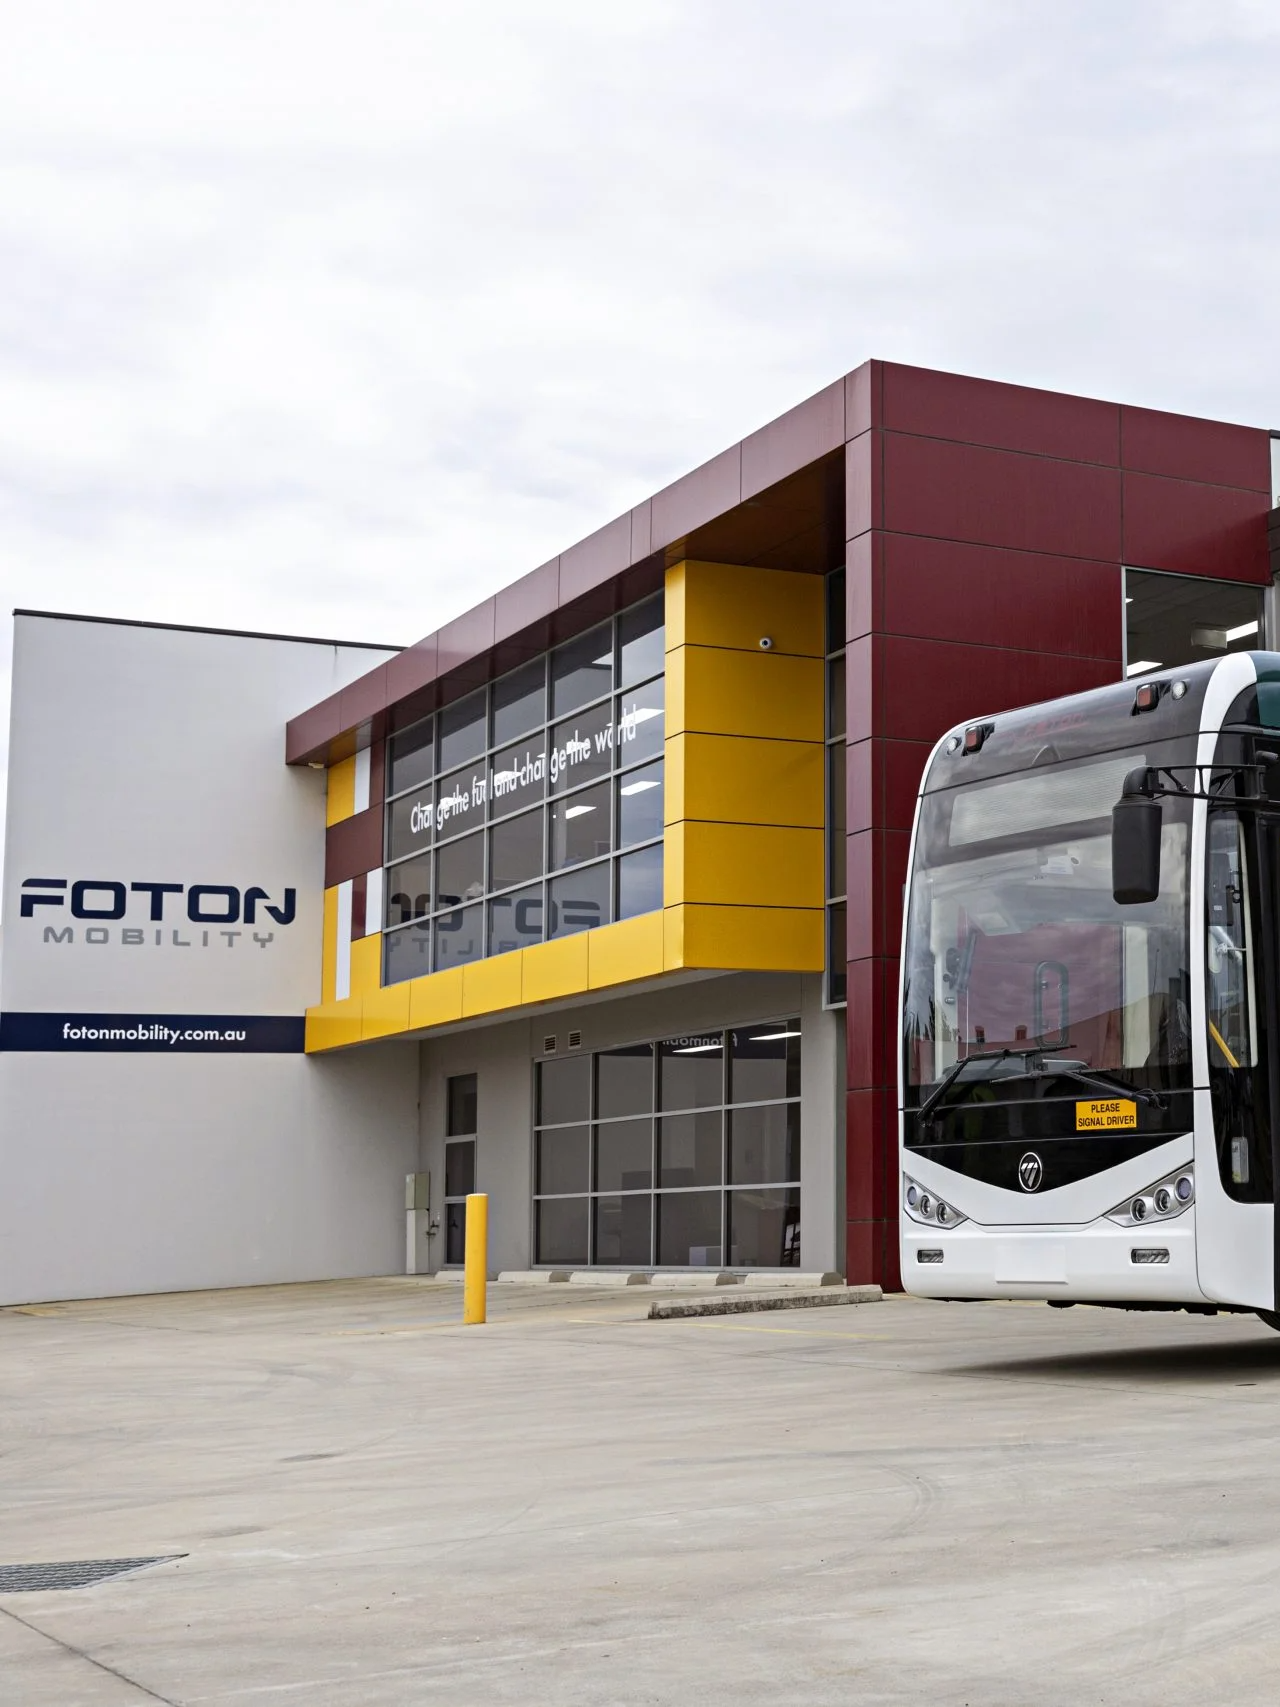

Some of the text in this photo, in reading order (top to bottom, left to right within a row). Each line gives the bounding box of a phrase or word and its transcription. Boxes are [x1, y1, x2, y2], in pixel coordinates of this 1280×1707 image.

[452, 784, 469, 816] the
[570, 730, 591, 766] the
[20, 878, 296, 925] FOTON
[43, 926, 274, 948] MOBILITY
[63, 1023, 246, 1044] fotonmobility.com.au
[1091, 1103, 1120, 1113] PLEASE
[1078, 1115, 1135, 1127] SIGNAL DRIVER
